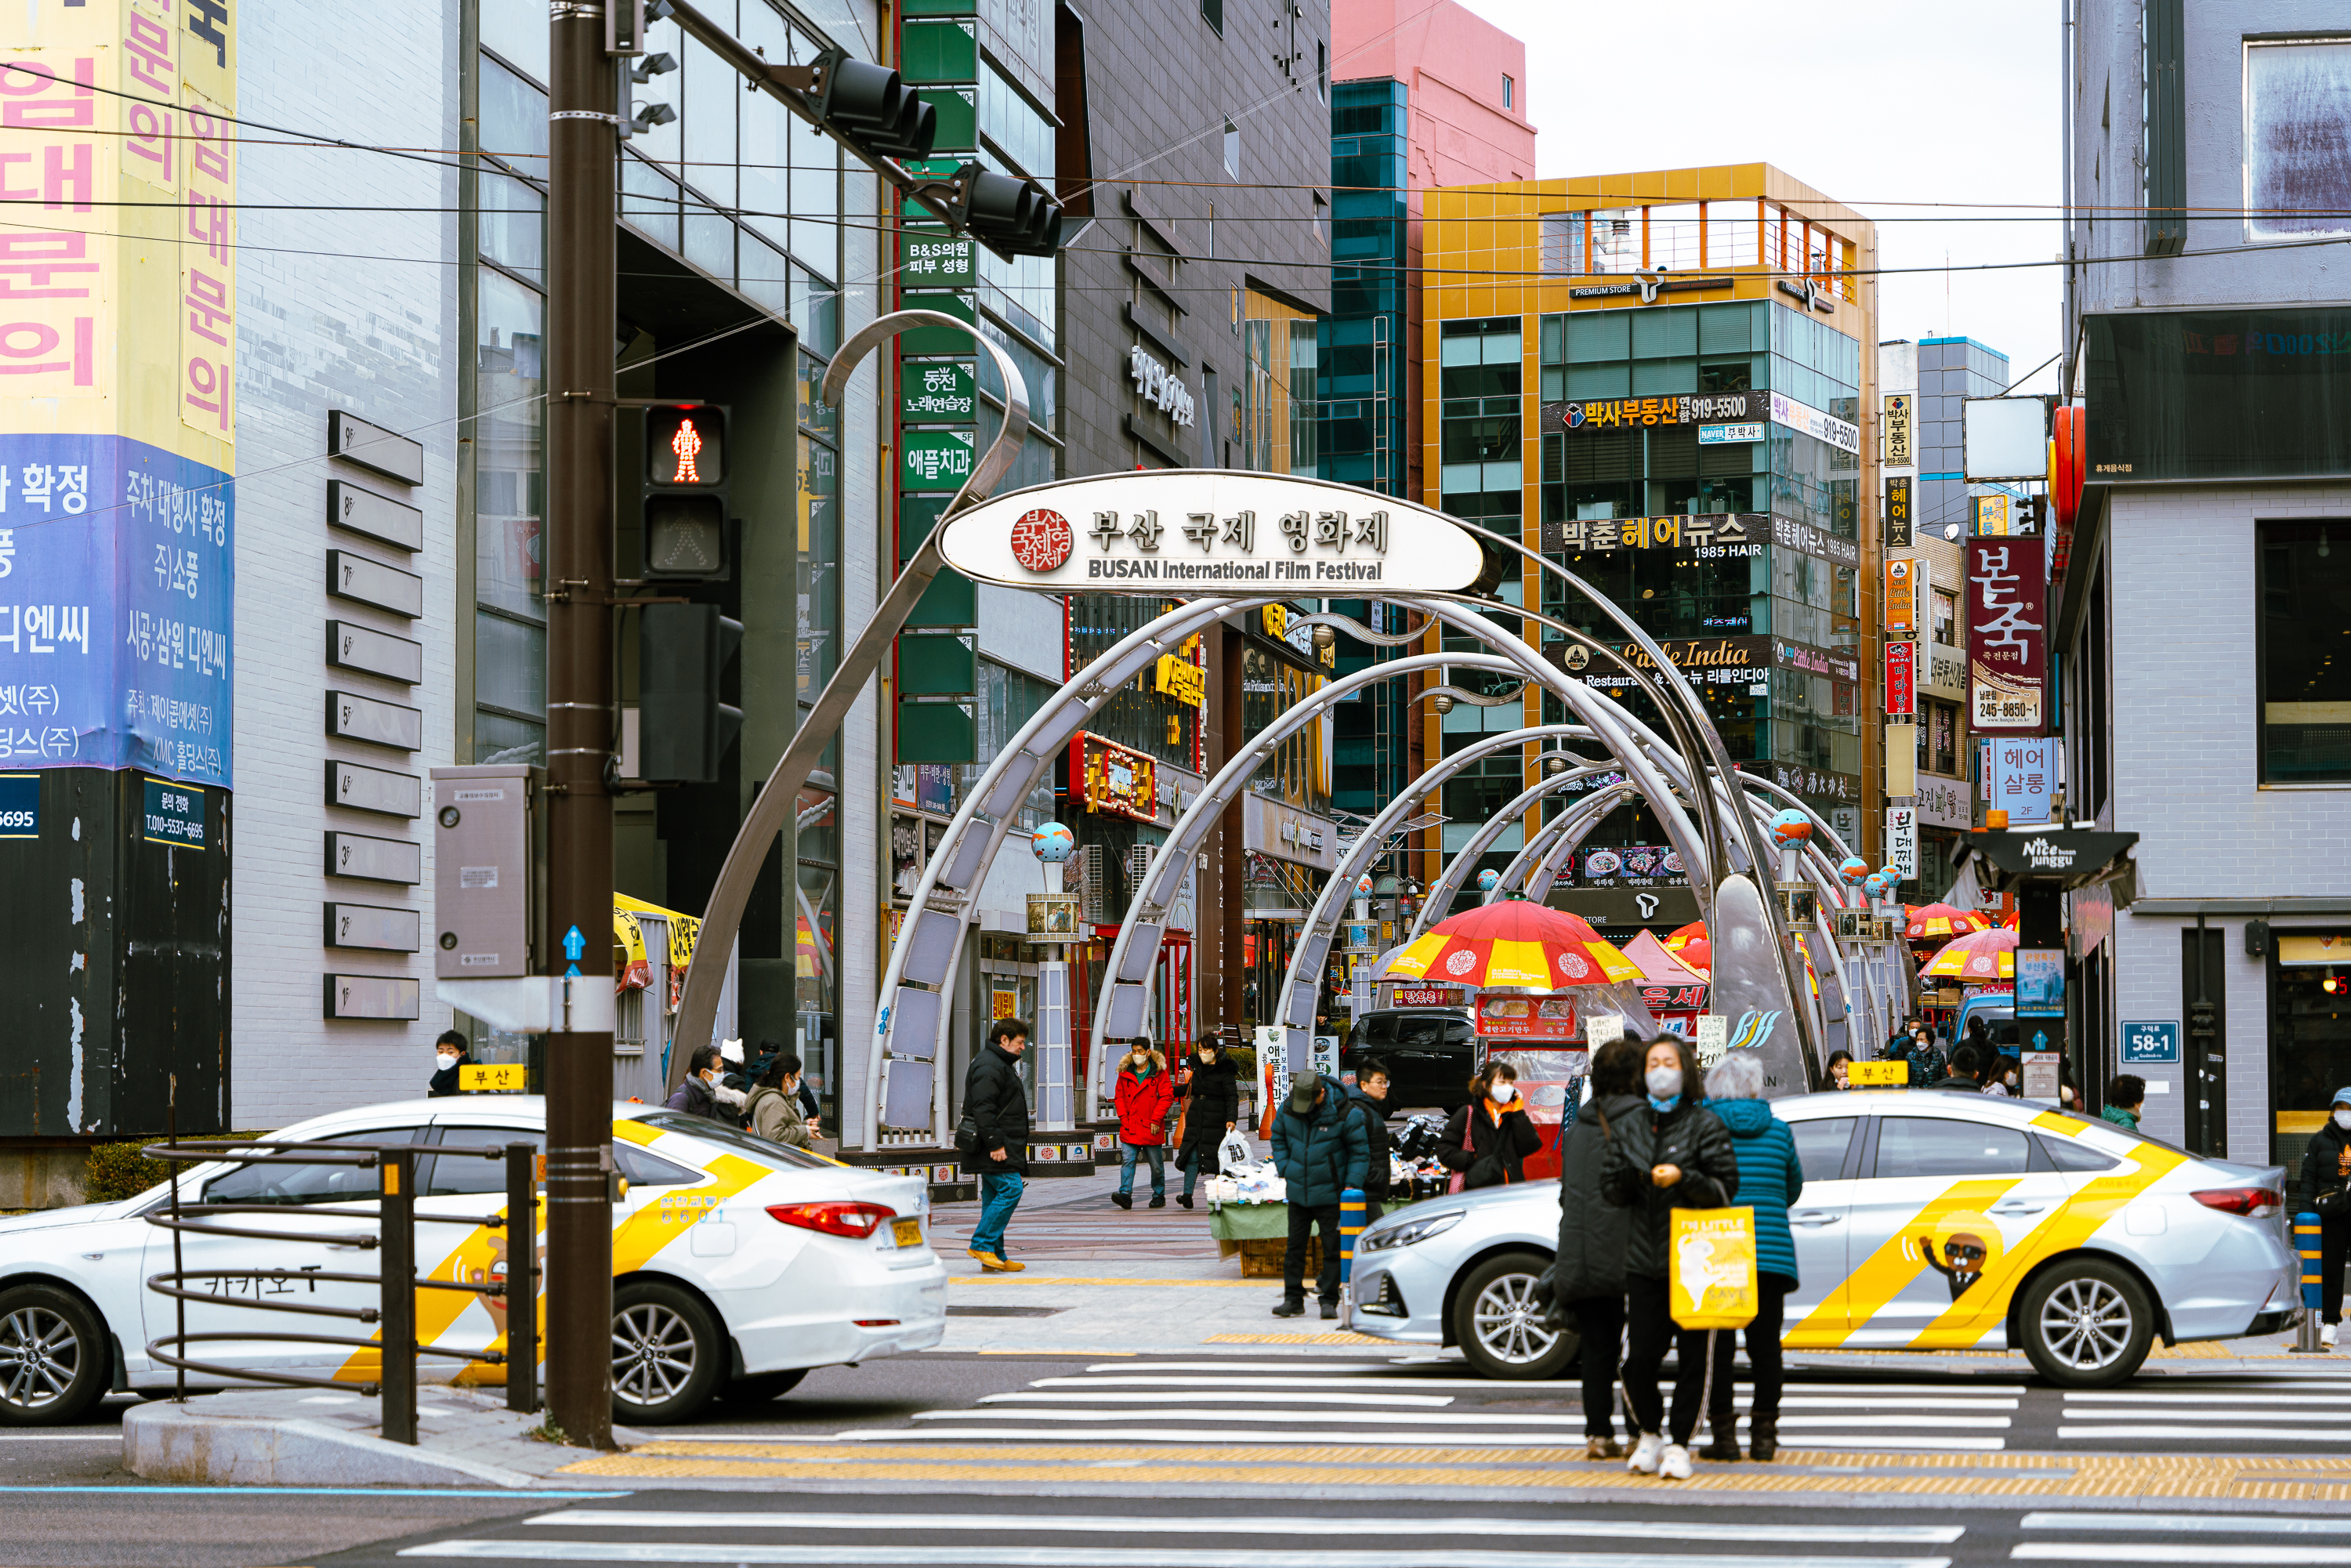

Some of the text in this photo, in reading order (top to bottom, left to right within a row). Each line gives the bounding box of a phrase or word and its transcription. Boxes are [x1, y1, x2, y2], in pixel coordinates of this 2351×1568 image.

[910, 243, 969, 257] B&S의원
[184, 104, 230, 431] 임대문의
[909, 259, 969, 273] 피부 성형
[1575, 285, 1632, 296] PREMIUM STORE
[906, 394, 973, 413] 노래연습장
[1585, 397, 1679, 428] 박사부동산
[1691, 396, 1746, 419] 919-5500
[1773, 396, 1810, 430] 박사부동산
[962, 433, 973, 441] 5F
[1701, 429, 1724, 440] NAVER
[1824, 417, 1857, 450] 919-5500
[907, 447, 971, 480] 애플치과
[2096, 463, 2132, 473] 휴게음식점
[22, 464, 88, 514] 확정
[126, 470, 226, 547] 주차 대행사 확정
[1892, 488, 1907, 546] 헤어뉴스
[1087, 509, 1389, 553] 부산 국제 영화제
[1563, 513, 1748, 552] 박춘헤어뉴스
[1775, 517, 1857, 561] 박춘헤어뉴스 1985 HAIR
[1695, 544, 1762, 558] 1985 HAIR
[154, 543, 199, 599] 주)소풍
[1088, 559, 1382, 580] BUSAN International Film Festival
[1887, 587, 1912, 598] Little
[1886, 599, 1912, 610] India
[1969, 546, 2043, 665] 본죽
[189, 625, 226, 680] 디엔씨
[1683, 640, 1751, 667] India
[1793, 646, 1810, 670] Little
[1811, 650, 1829, 674] India
[1690, 671, 1704, 684] 뉴
[1707, 668, 1770, 684] 리틀인디아
[1895, 664, 1907, 707] 마라탕
[1979, 690, 1997, 700] 남포점
[1980, 702, 2038, 717] 245-8850~1
[2005, 748, 2044, 770] 헤어
[2005, 773, 2045, 795] 살롱
[161, 791, 189, 813] 문의 전화
[2021, 806, 2033, 815] 2F
[146, 813, 203, 839] T.010-5537-6695
[2023, 841, 2059, 856] Nice
[2030, 855, 2074, 868] junggu
[1583, 915, 1607, 924] STORE
[993, 991, 1015, 1019] 임대문의
[1640, 985, 1706, 1008] 운세
[2132, 1034, 2169, 1051] 58-1
[473, 1069, 511, 1086] 부산
[1862, 1065, 1895, 1082] 부산
[661, 1209, 725, 1223] 6601
